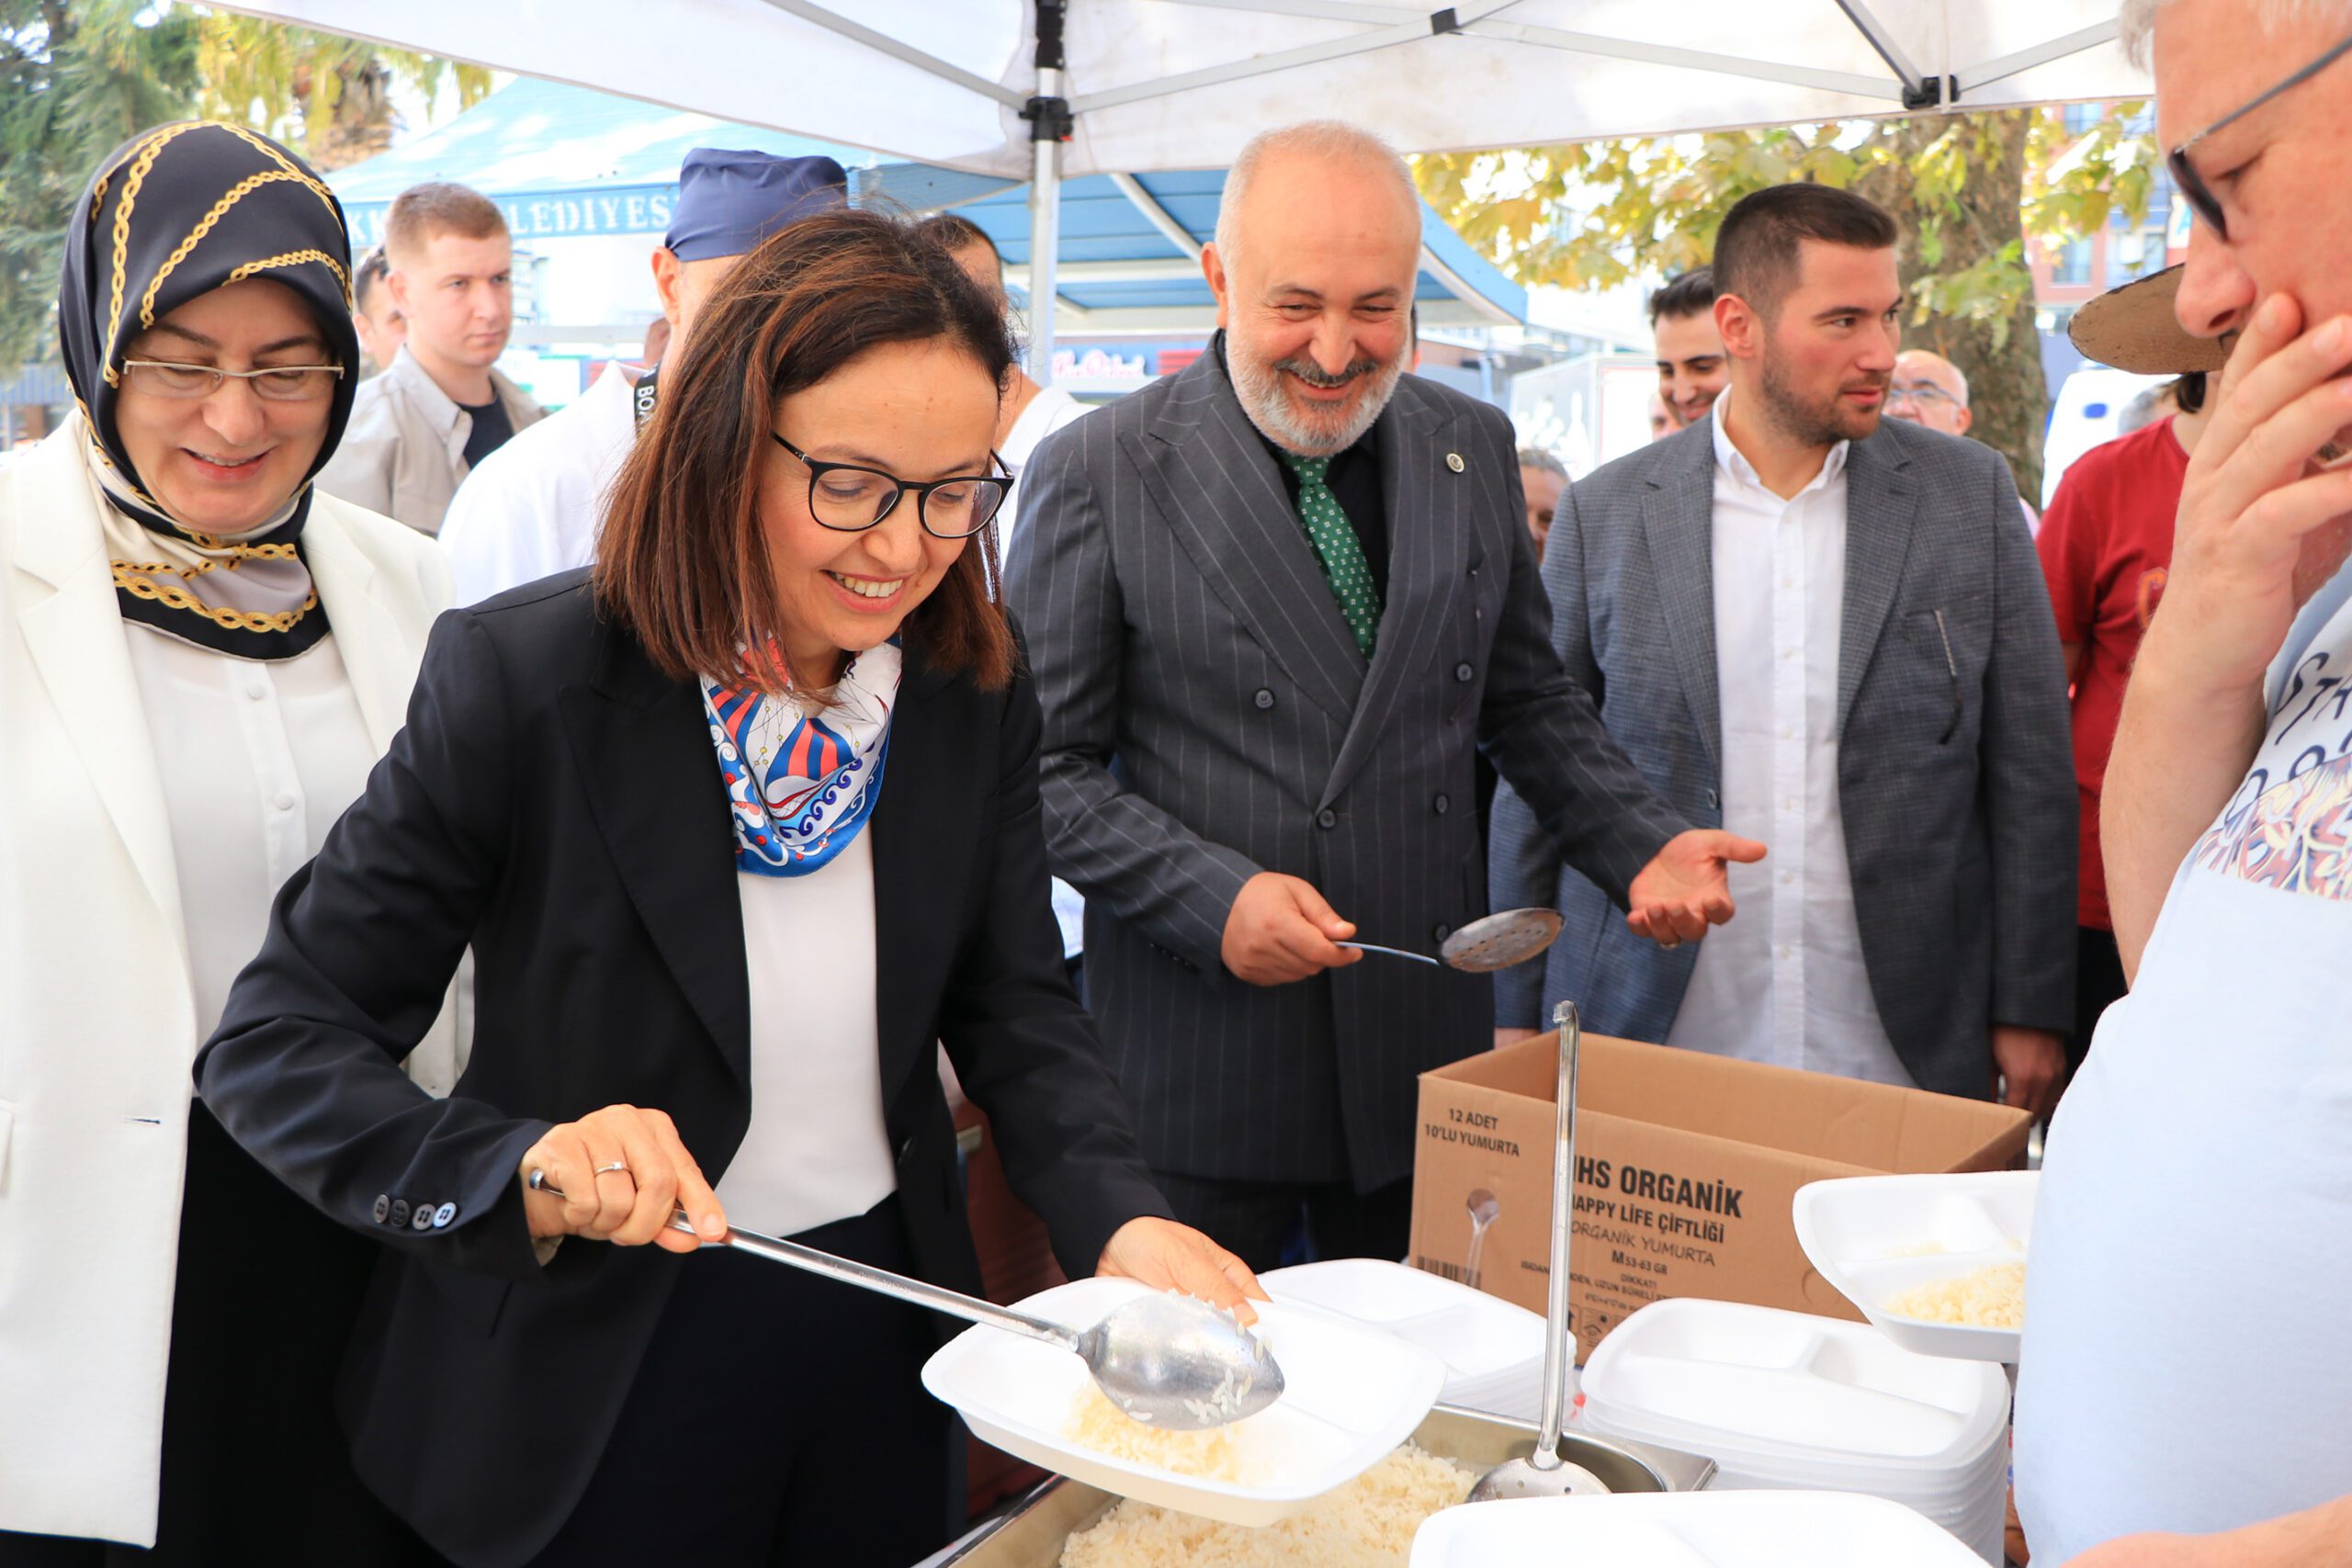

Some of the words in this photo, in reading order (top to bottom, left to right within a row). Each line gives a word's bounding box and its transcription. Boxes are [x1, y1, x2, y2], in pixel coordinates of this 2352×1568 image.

[1449, 1108, 1463, 1122] 12
[1465, 1111, 1498, 1130] ADET
[1459, 1131, 1520, 1157] YUMURTA
[1620, 1165, 1743, 1219] ORGANİK
[1620, 1203, 1653, 1228] LİFE
[1657, 1213, 1724, 1245] ÇİFTLİĞİ
[1641, 1236, 1716, 1267] YUMURTA
